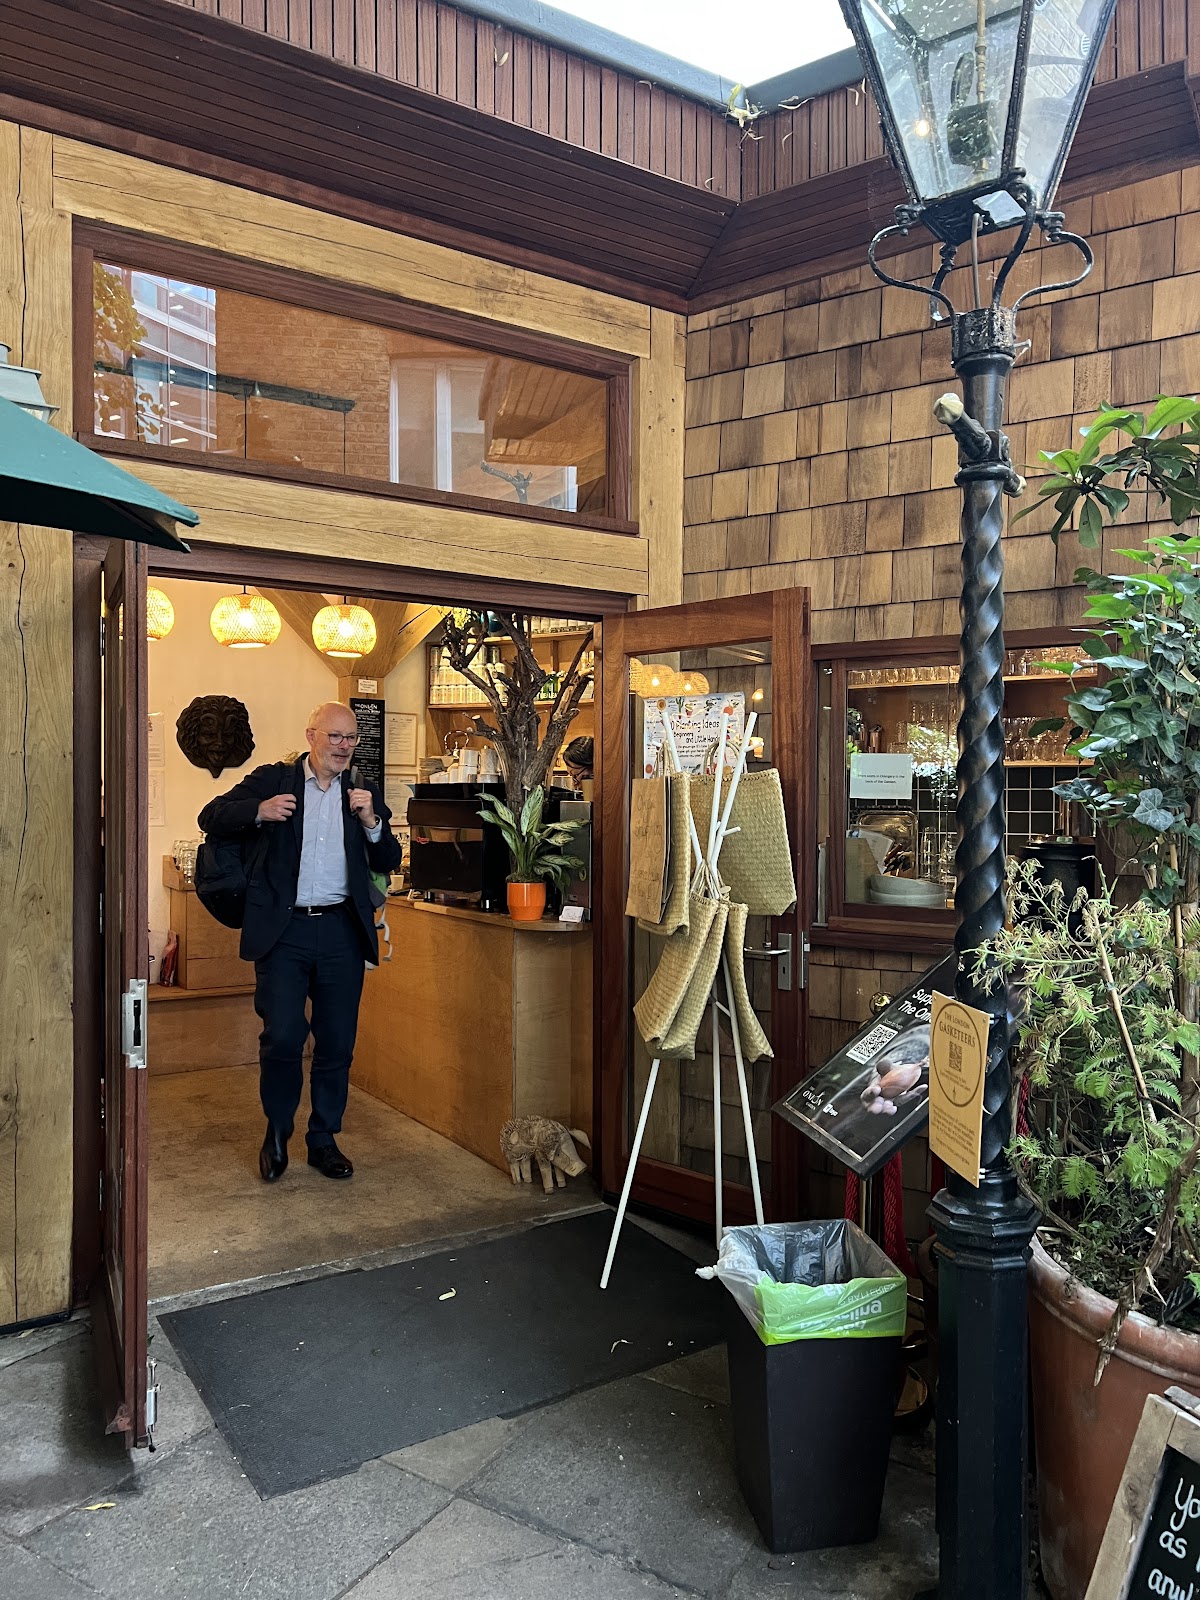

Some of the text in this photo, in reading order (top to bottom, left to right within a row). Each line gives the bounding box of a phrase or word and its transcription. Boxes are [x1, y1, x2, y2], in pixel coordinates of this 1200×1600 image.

[702, 719, 720, 729] Ideas
[897, 1000, 917, 1015] The
[952, 1015, 970, 1029] LONDON
[939, 1020, 976, 1048] GASKETEERS
[802, 1089, 824, 1107] ONION
[1159, 1530, 1188, 1560] as
